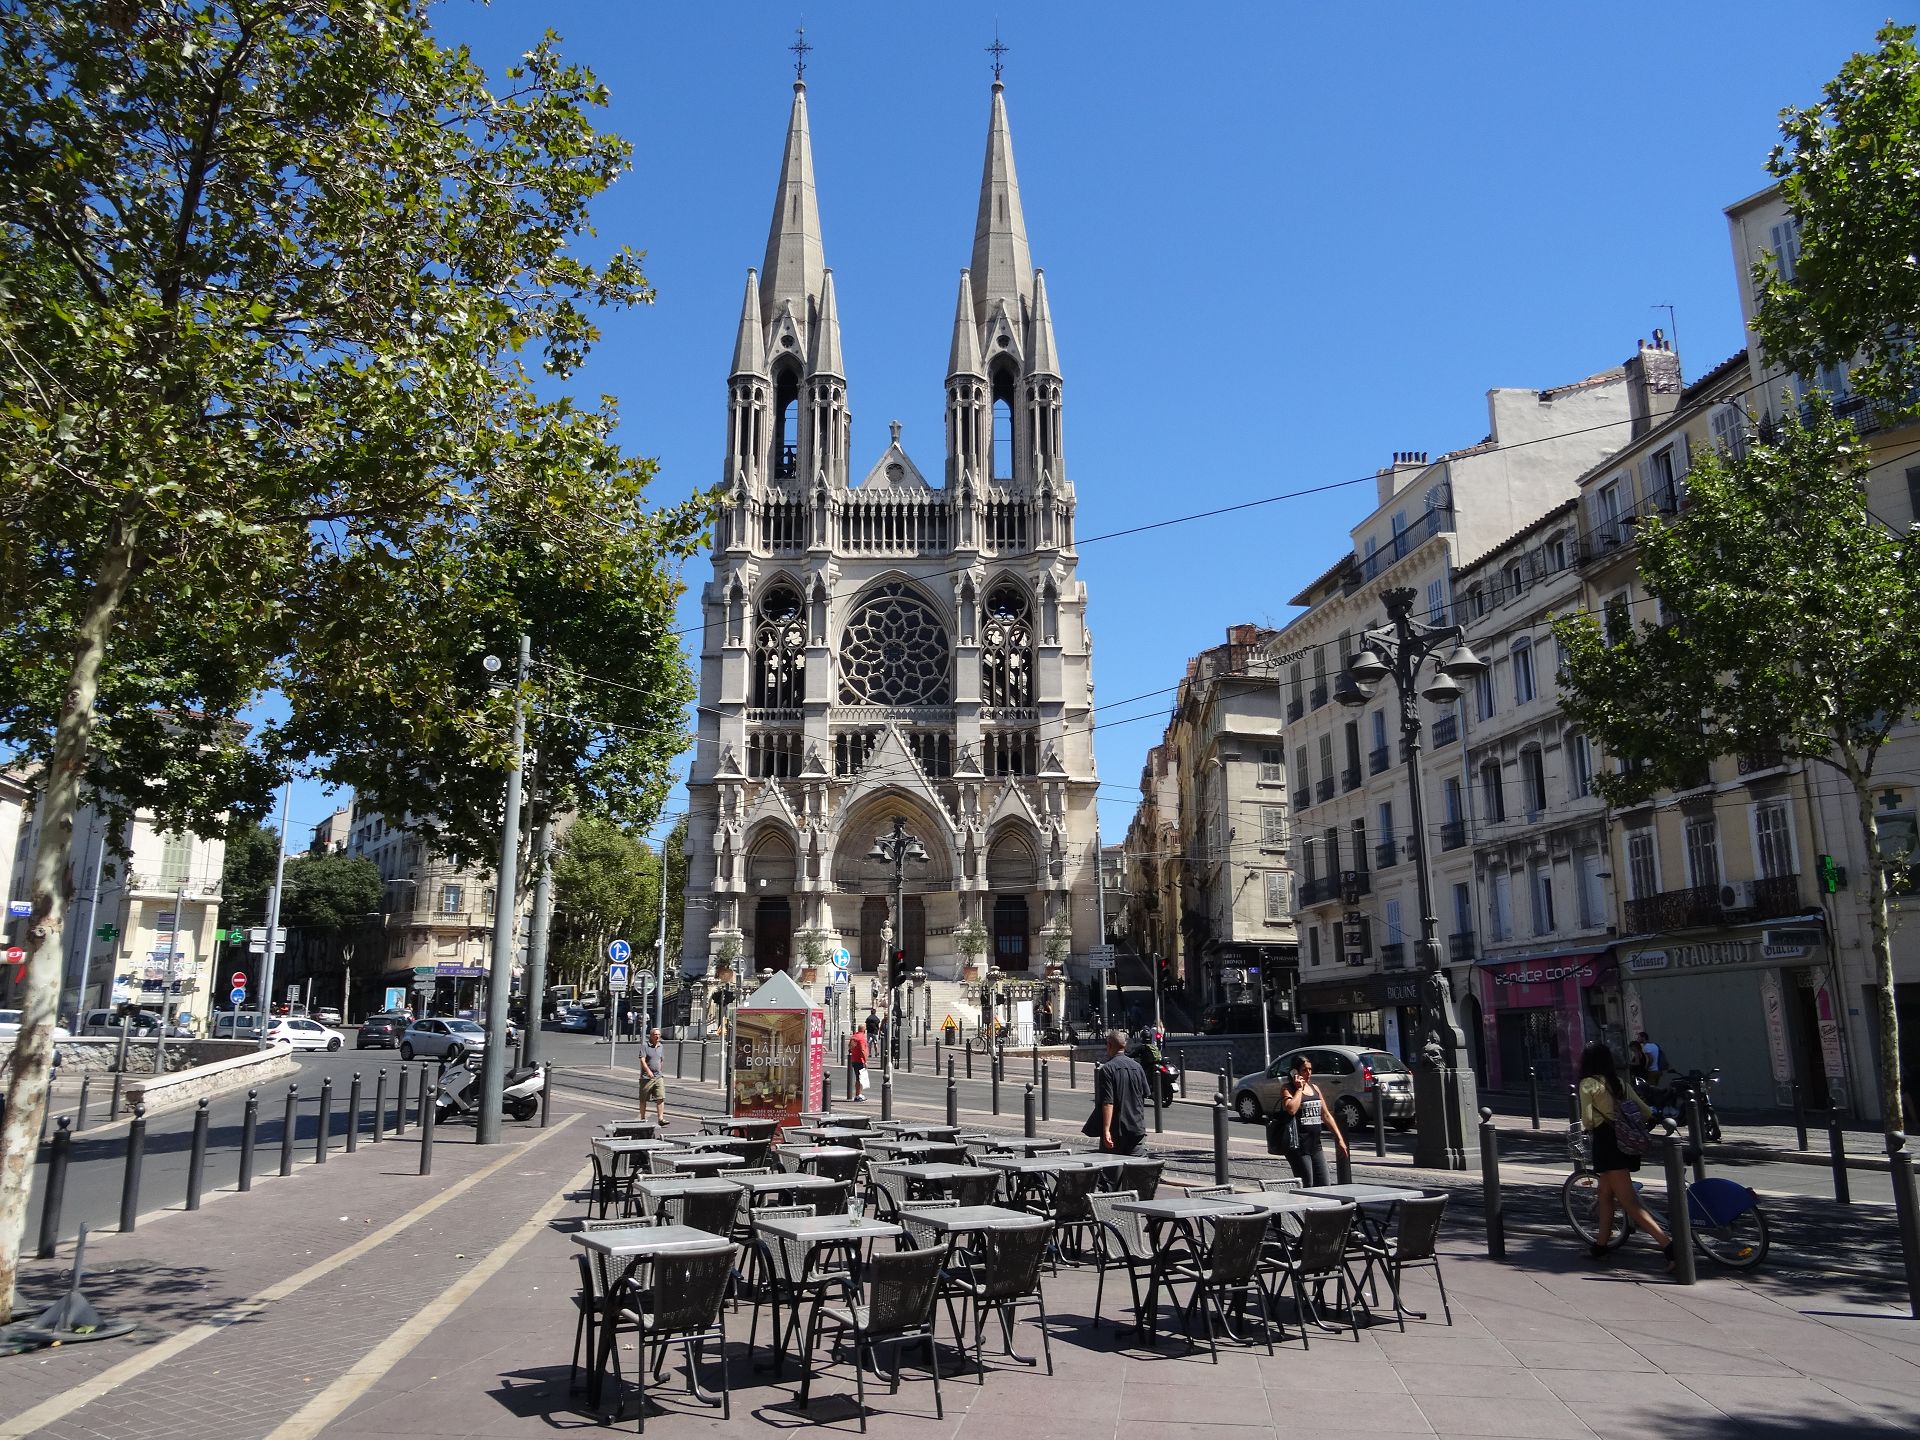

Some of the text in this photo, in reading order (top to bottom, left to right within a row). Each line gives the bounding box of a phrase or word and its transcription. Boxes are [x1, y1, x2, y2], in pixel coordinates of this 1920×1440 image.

[1495, 964, 1593, 986] espace copies
[743, 1041, 801, 1054] CHÂTEAU
[746, 1054, 796, 1067] BORÉLY
